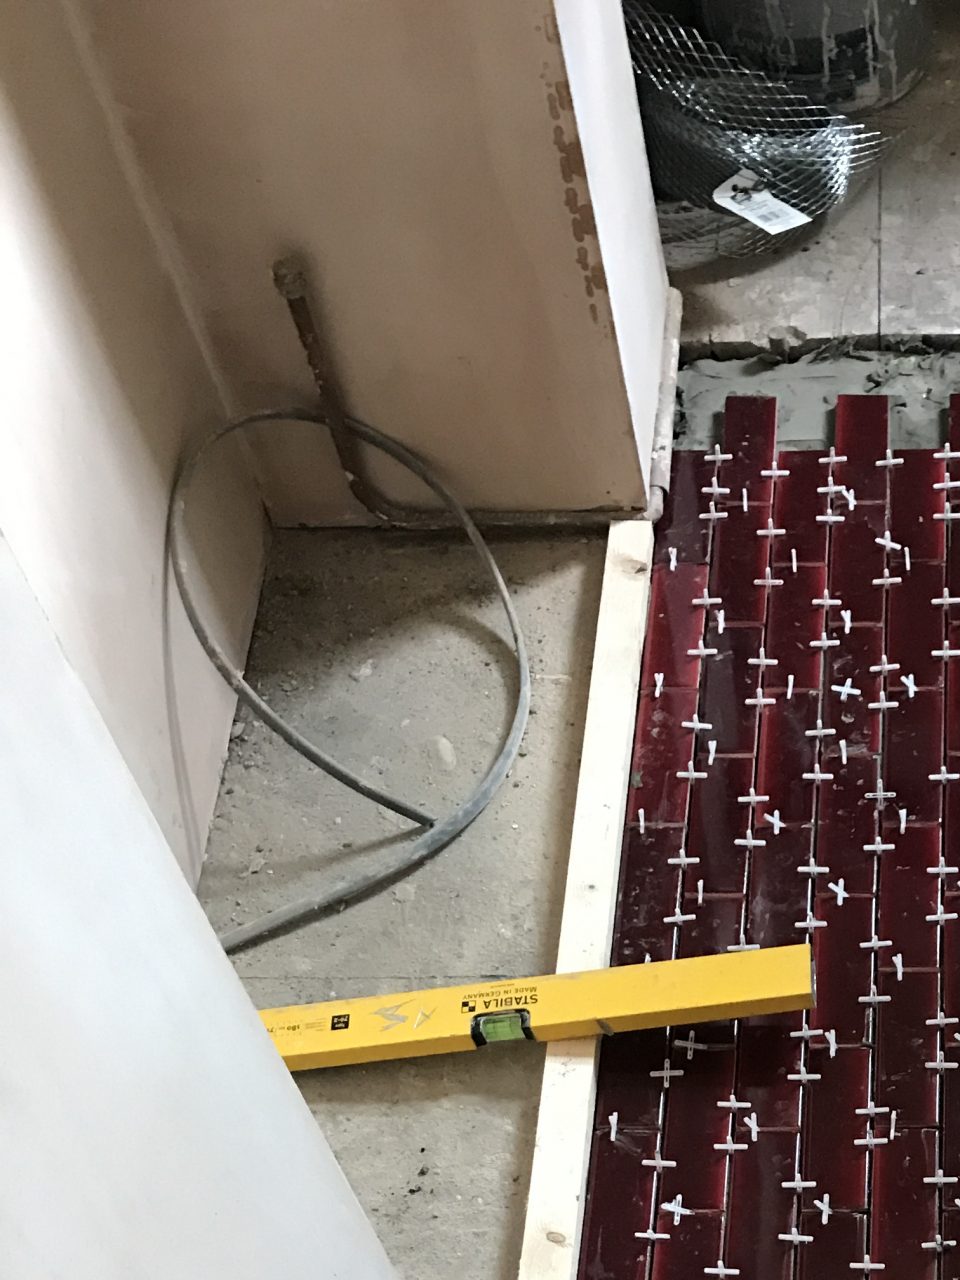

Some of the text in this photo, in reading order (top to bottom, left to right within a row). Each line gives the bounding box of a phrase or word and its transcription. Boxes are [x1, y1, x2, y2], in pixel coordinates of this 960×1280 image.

[463, 990, 501, 1000] GERMANY
[514, 986, 538, 994] MADE
[483, 993, 539, 1009] STABILA
